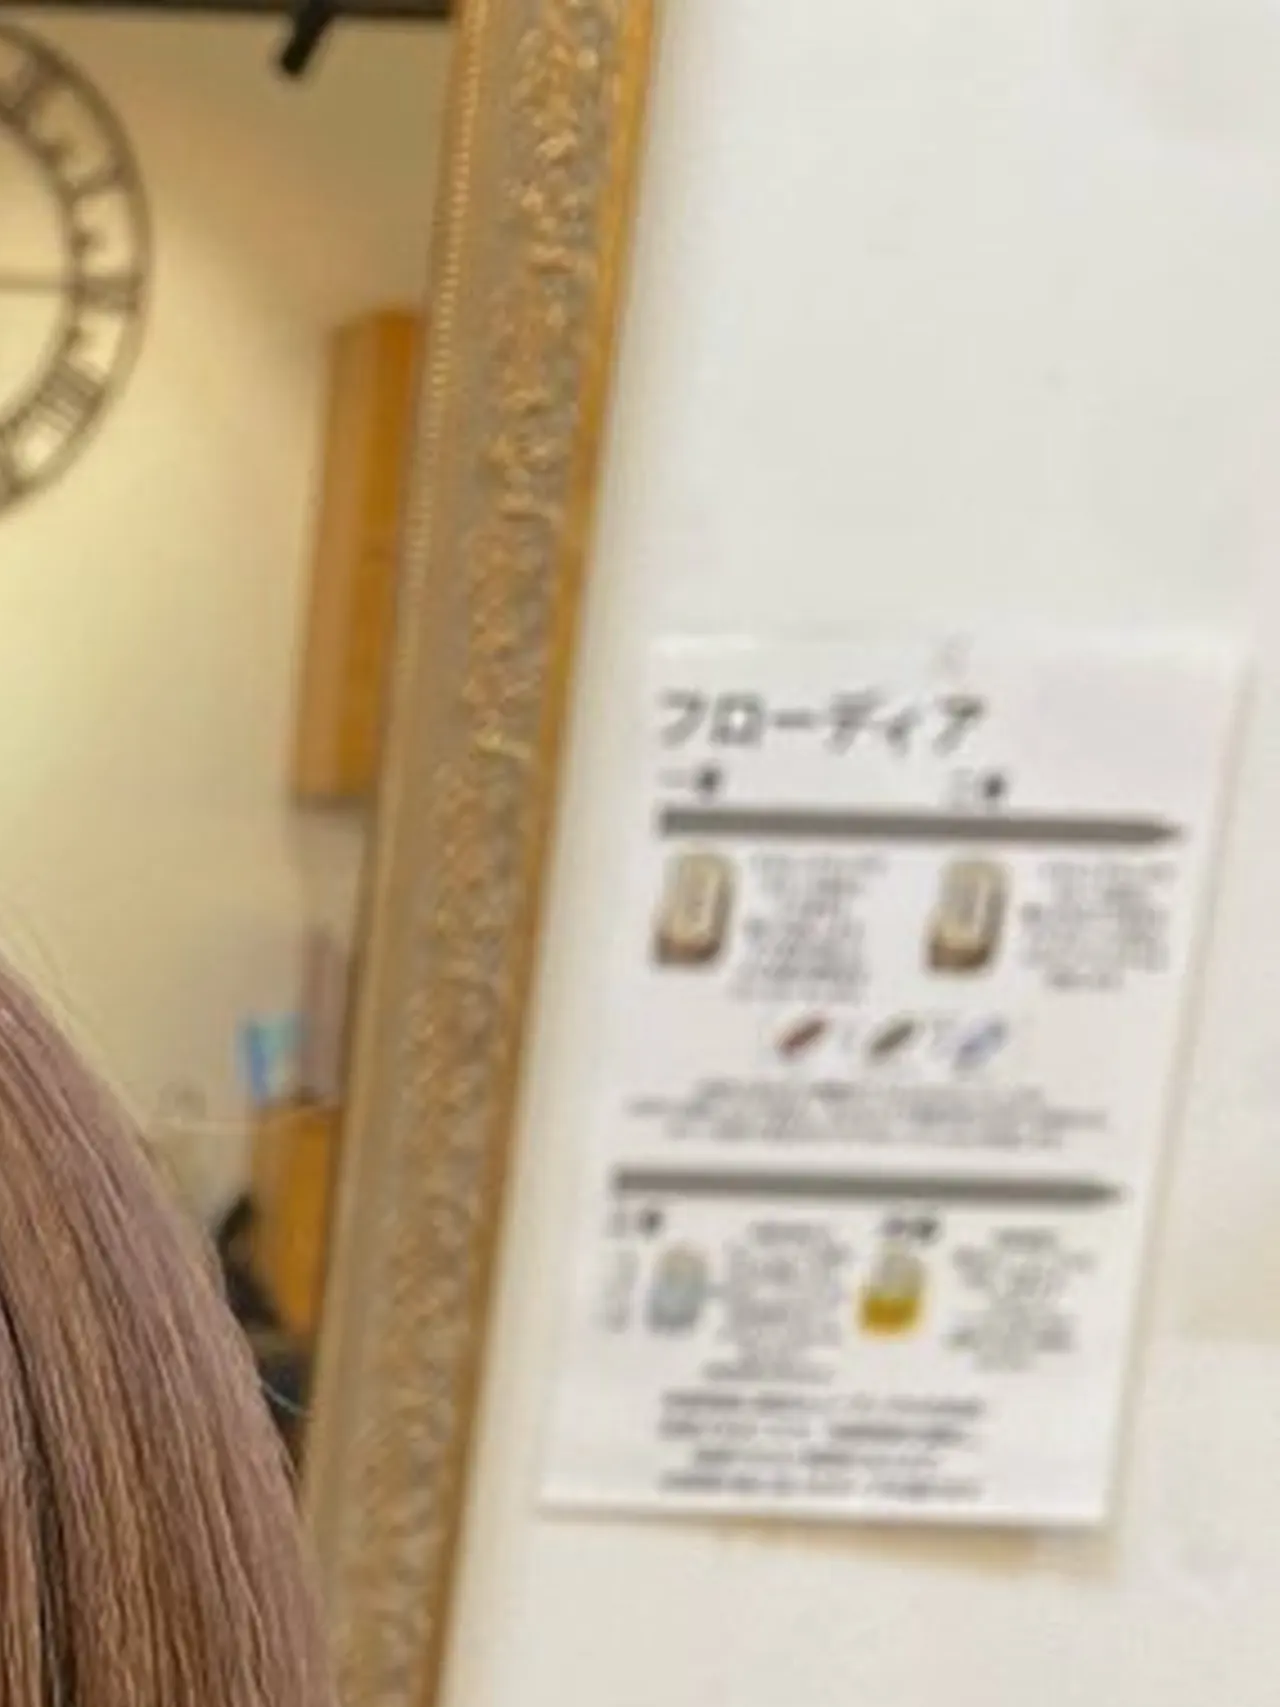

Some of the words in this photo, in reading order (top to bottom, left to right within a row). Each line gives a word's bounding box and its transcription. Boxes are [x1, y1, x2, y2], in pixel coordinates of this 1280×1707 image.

[660, 687, 985, 757] フローディア
